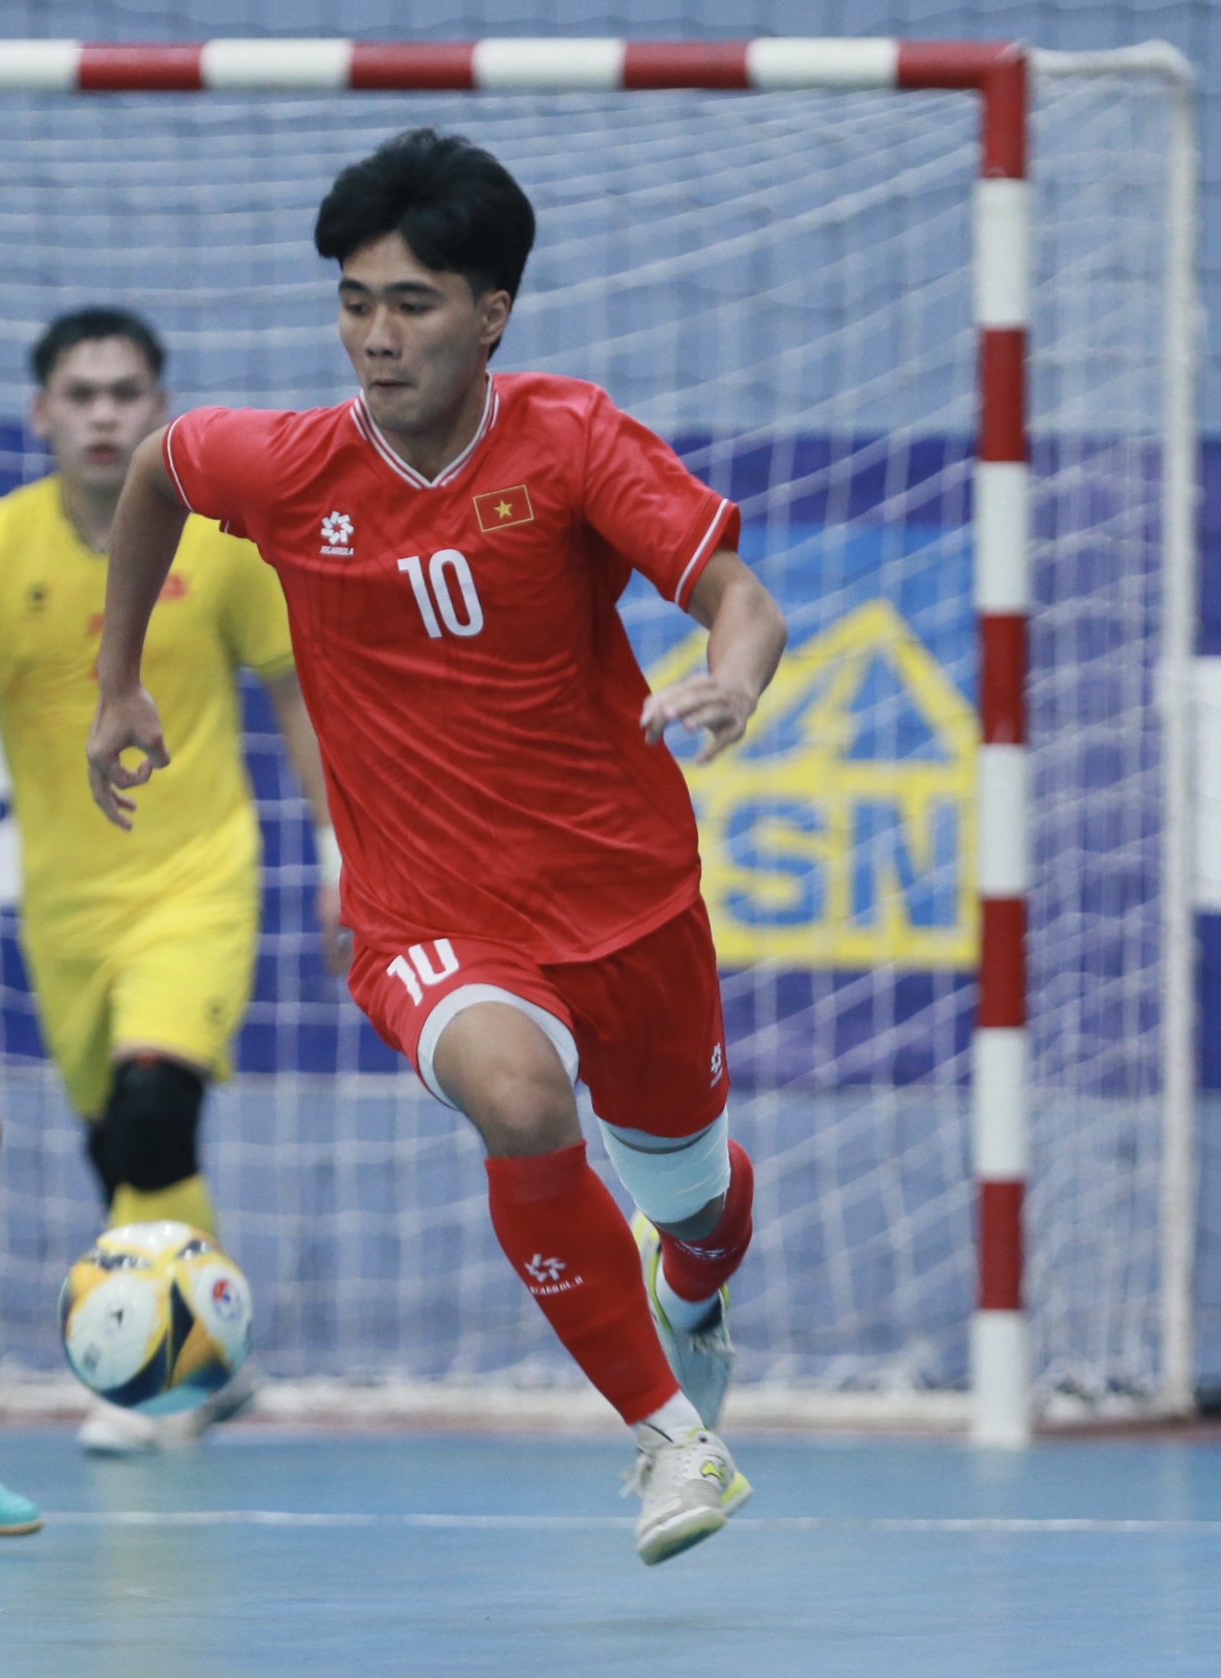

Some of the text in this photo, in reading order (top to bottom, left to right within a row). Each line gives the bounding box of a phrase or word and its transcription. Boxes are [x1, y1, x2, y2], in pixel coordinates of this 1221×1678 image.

[397, 549, 484, 638] 10
[692, 797, 957, 927] SN
[386, 937, 459, 1007] 10
